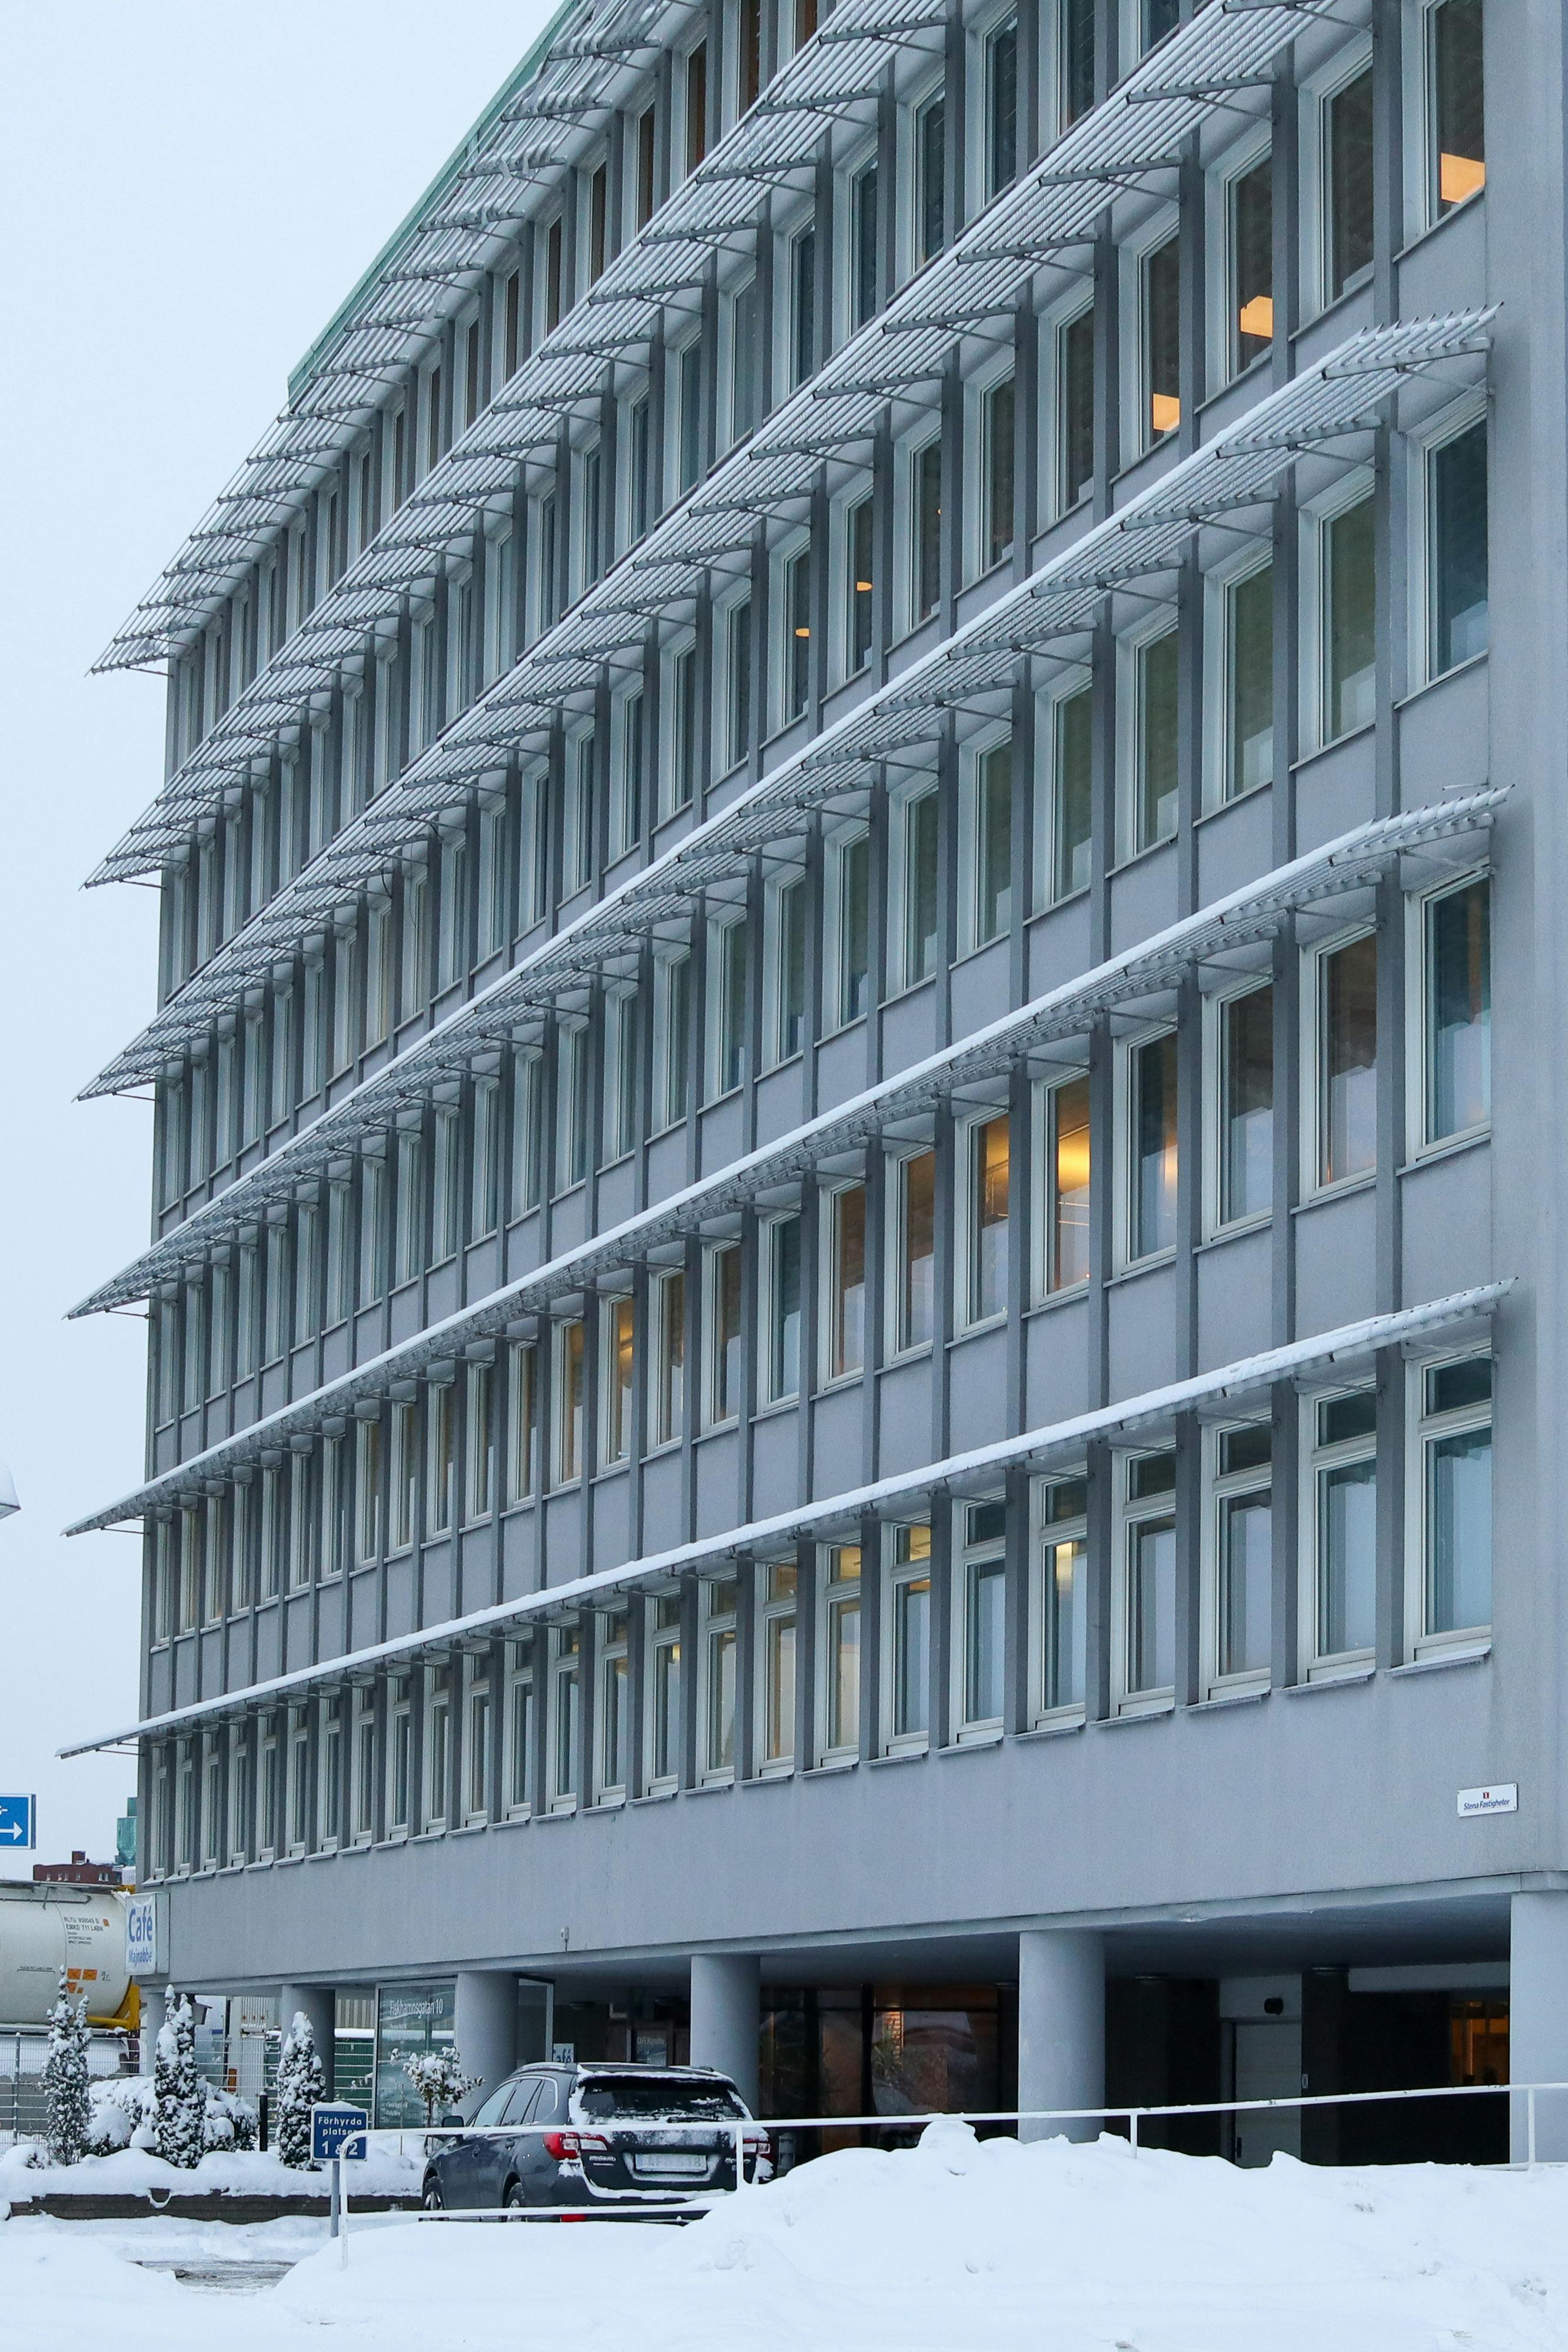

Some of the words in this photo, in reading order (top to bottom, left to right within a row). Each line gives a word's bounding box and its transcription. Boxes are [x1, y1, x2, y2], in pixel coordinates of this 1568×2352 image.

[1480, 1799, 1510, 1809] Fastigheter
[129, 1905, 152, 1942] Café
[390, 1999, 434, 2019] Fiskhamnsgatan
[436, 1998, 443, 2014] 10
[553, 2049, 571, 2062] afé
[318, 2117, 362, 2127] Förhyrda
[322, 2141, 328, 2154] 1
[348, 2141, 358, 2155] 2
